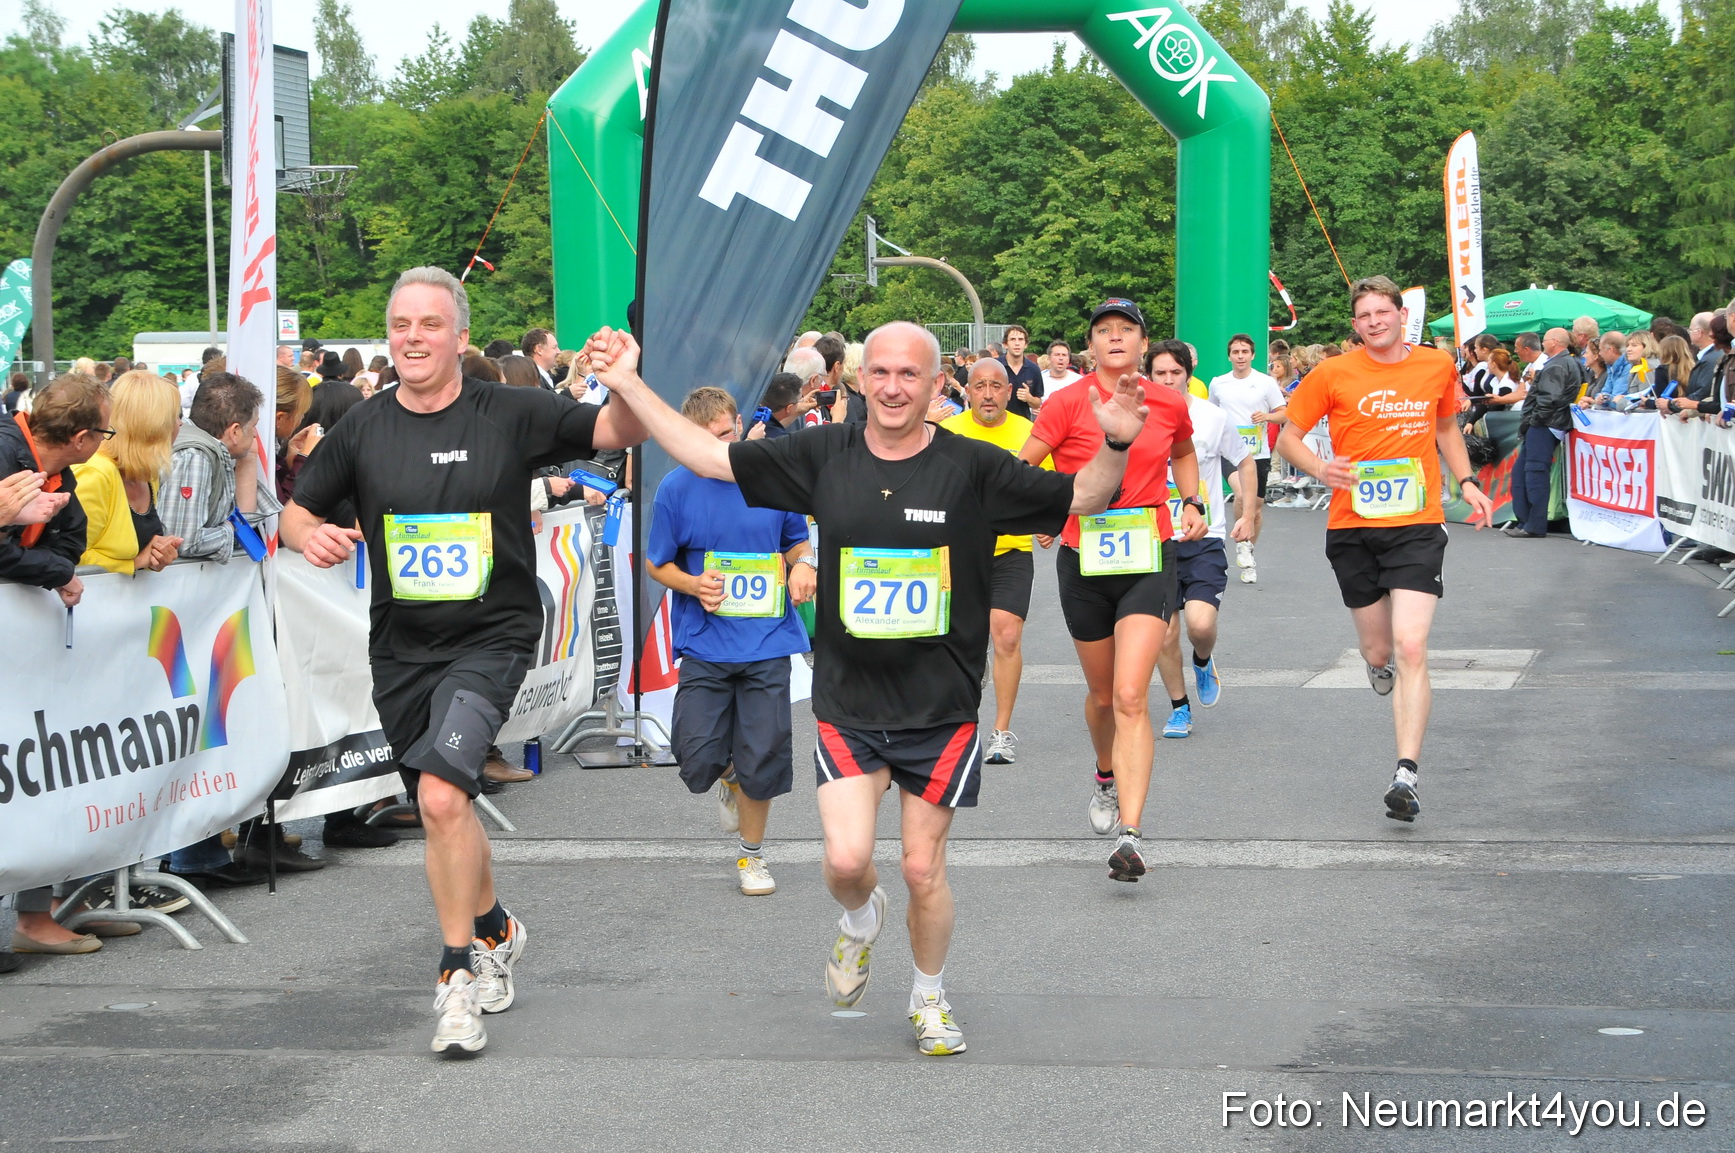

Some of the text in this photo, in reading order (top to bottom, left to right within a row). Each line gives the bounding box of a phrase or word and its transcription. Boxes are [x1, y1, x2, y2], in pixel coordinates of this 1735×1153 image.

[1105, 7, 1238, 120] AOK
[1455, 157, 1471, 276] KLEBL
[1470, 166, 1481, 248] www.klebl.de
[1371, 397, 1430, 413] Fischer
[1377, 411, 1425, 419] AUTOMOBILE
[430, 450, 468, 464] THULE
[1575, 437, 1648, 511] MEIER
[1359, 478, 1409, 503] 997
[904, 508, 946, 523] THULE
[1098, 531, 1130, 558] 51
[398, 544, 469, 578] 263
[413, 578, 436, 587] Frank
[723, 600, 746, 608] Gregor
[853, 580, 928, 615] 270
[855, 616, 900, 625] Alexander
[0, 703, 200, 804] schmann
[341, 750, 365, 769] die
[85, 792, 147, 833] Druck
[165, 770, 238, 807] Medien
